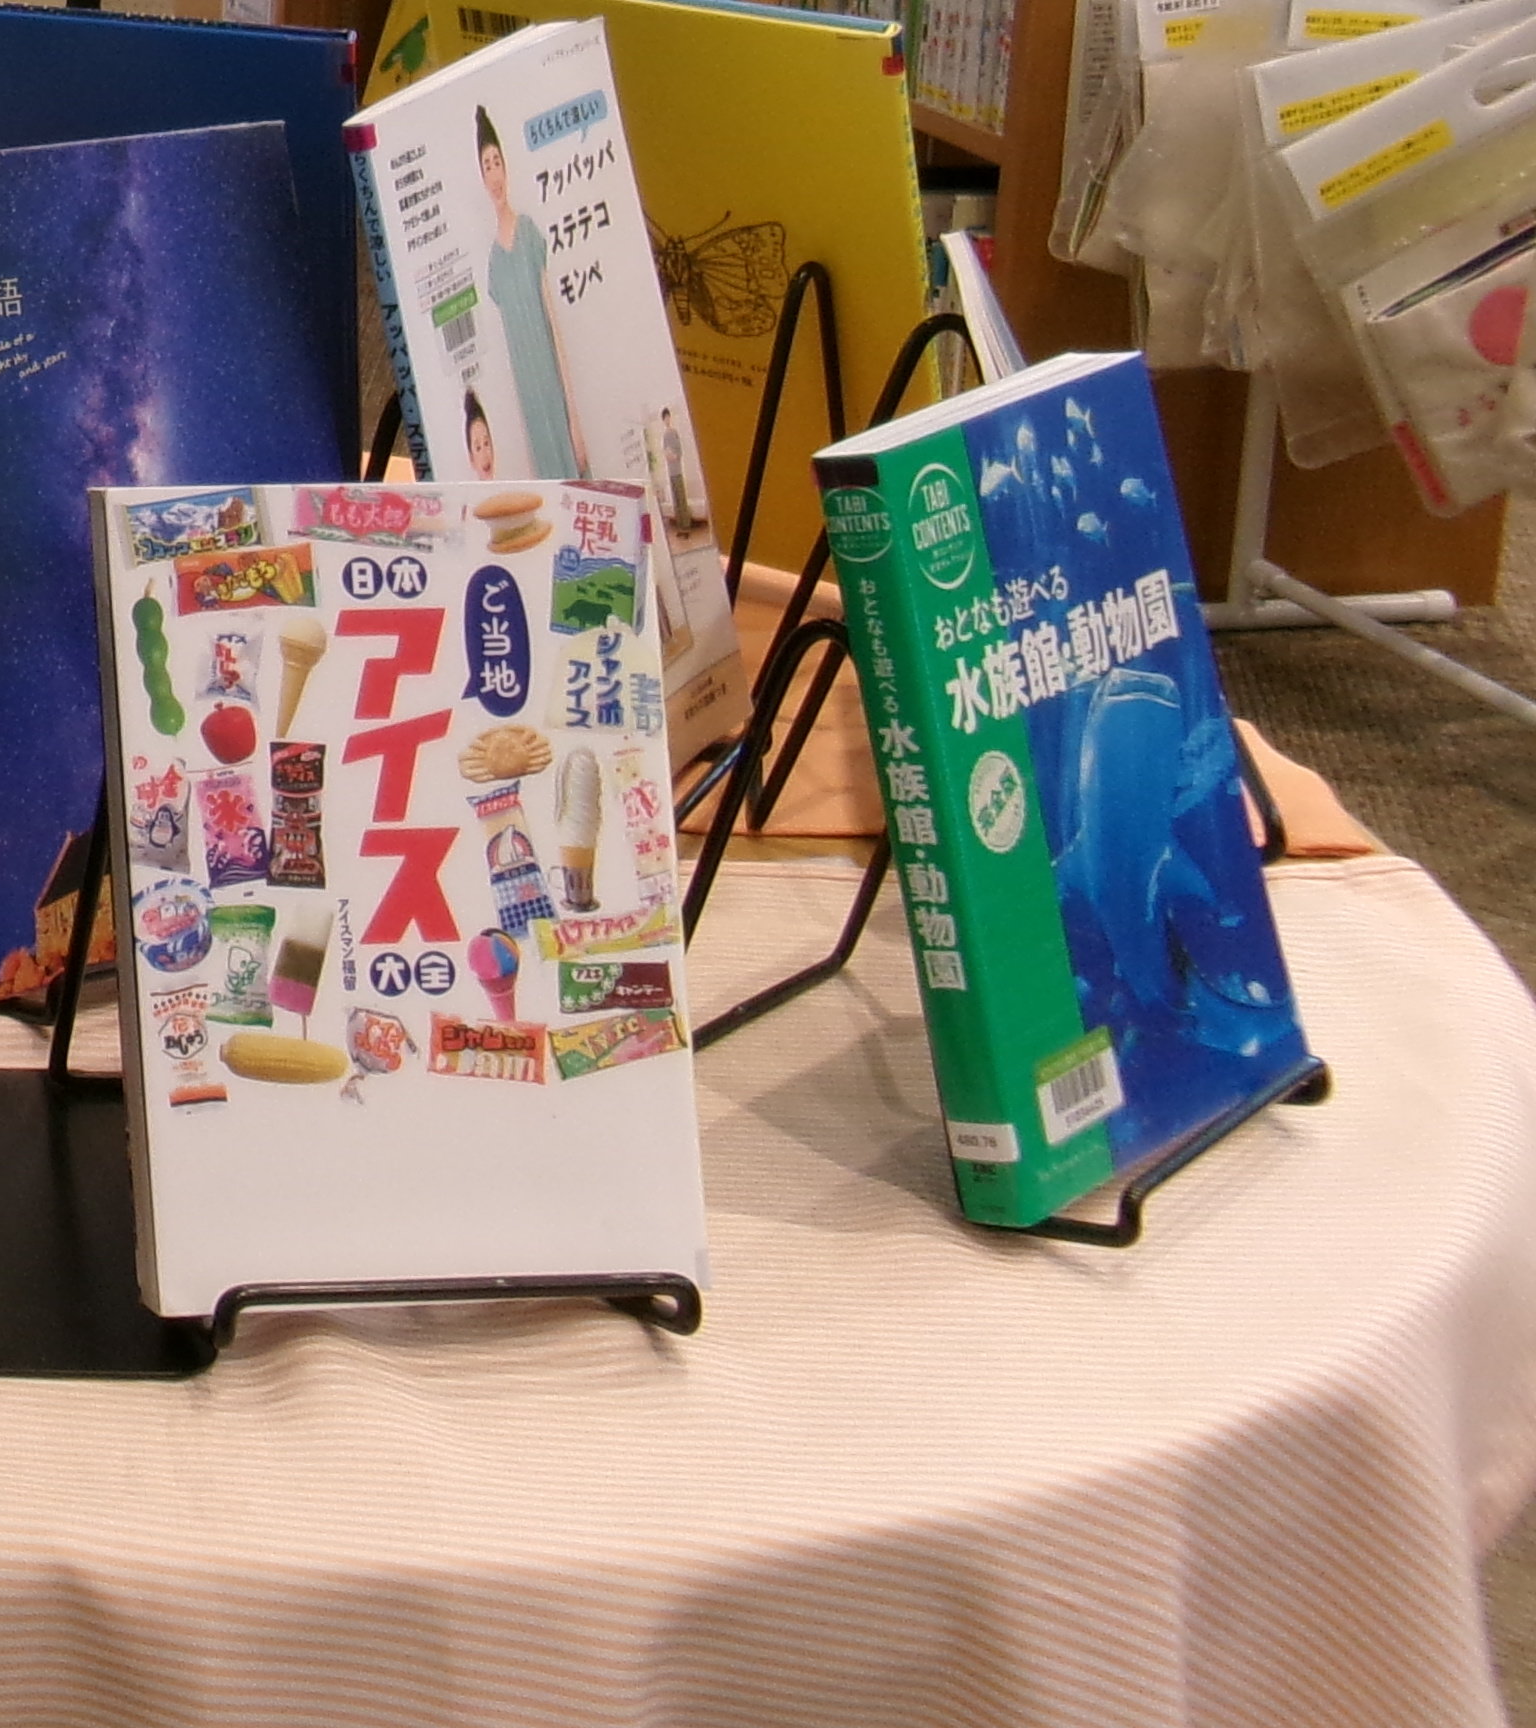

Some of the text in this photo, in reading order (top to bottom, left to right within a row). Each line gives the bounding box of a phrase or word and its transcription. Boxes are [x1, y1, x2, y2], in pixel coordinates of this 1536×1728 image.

[536, 142, 615, 203] アッパッパ
[548, 203, 612, 255] ステテコ
[560, 264, 604, 306] モンペ
[573, 516, 618, 544] 牛乳
[348, 559, 424, 597] 日本
[480, 583, 521, 698] ご当地
[935, 569, 1070, 653] おとなも遊べる
[946, 569, 1180, 735] 水族館・動物園
[334, 608, 462, 944] アイス
[858, 579, 966, 991] おとなも遊べる 水族館・動物園
[374, 957, 452, 993] 大全
